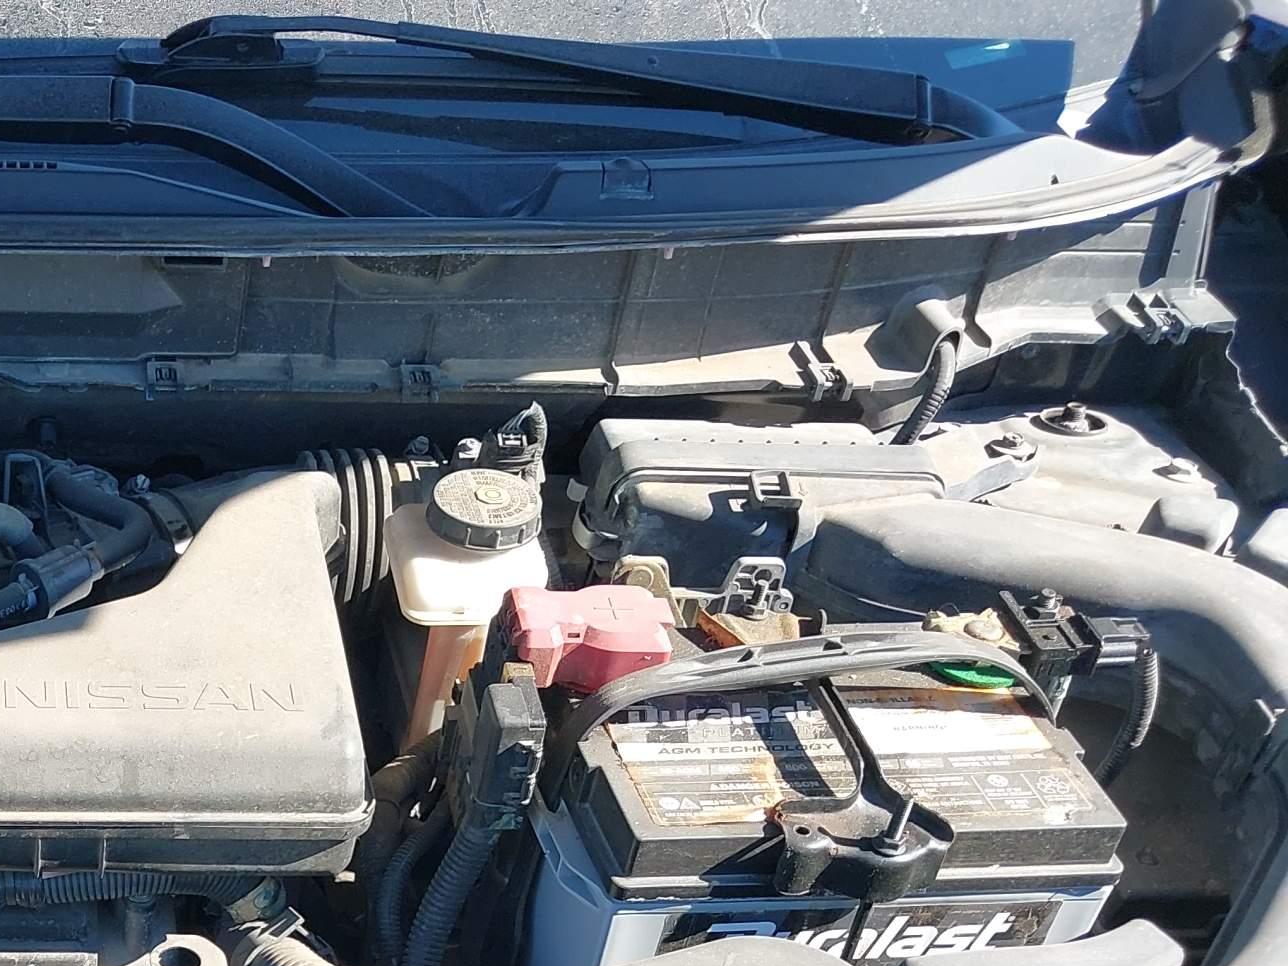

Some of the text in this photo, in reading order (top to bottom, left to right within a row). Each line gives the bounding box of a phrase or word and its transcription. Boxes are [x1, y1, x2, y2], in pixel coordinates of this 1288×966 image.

[3, 679, 305, 711] NISSAN
[658, 742, 835, 755] AGM TECHNOLOGY
